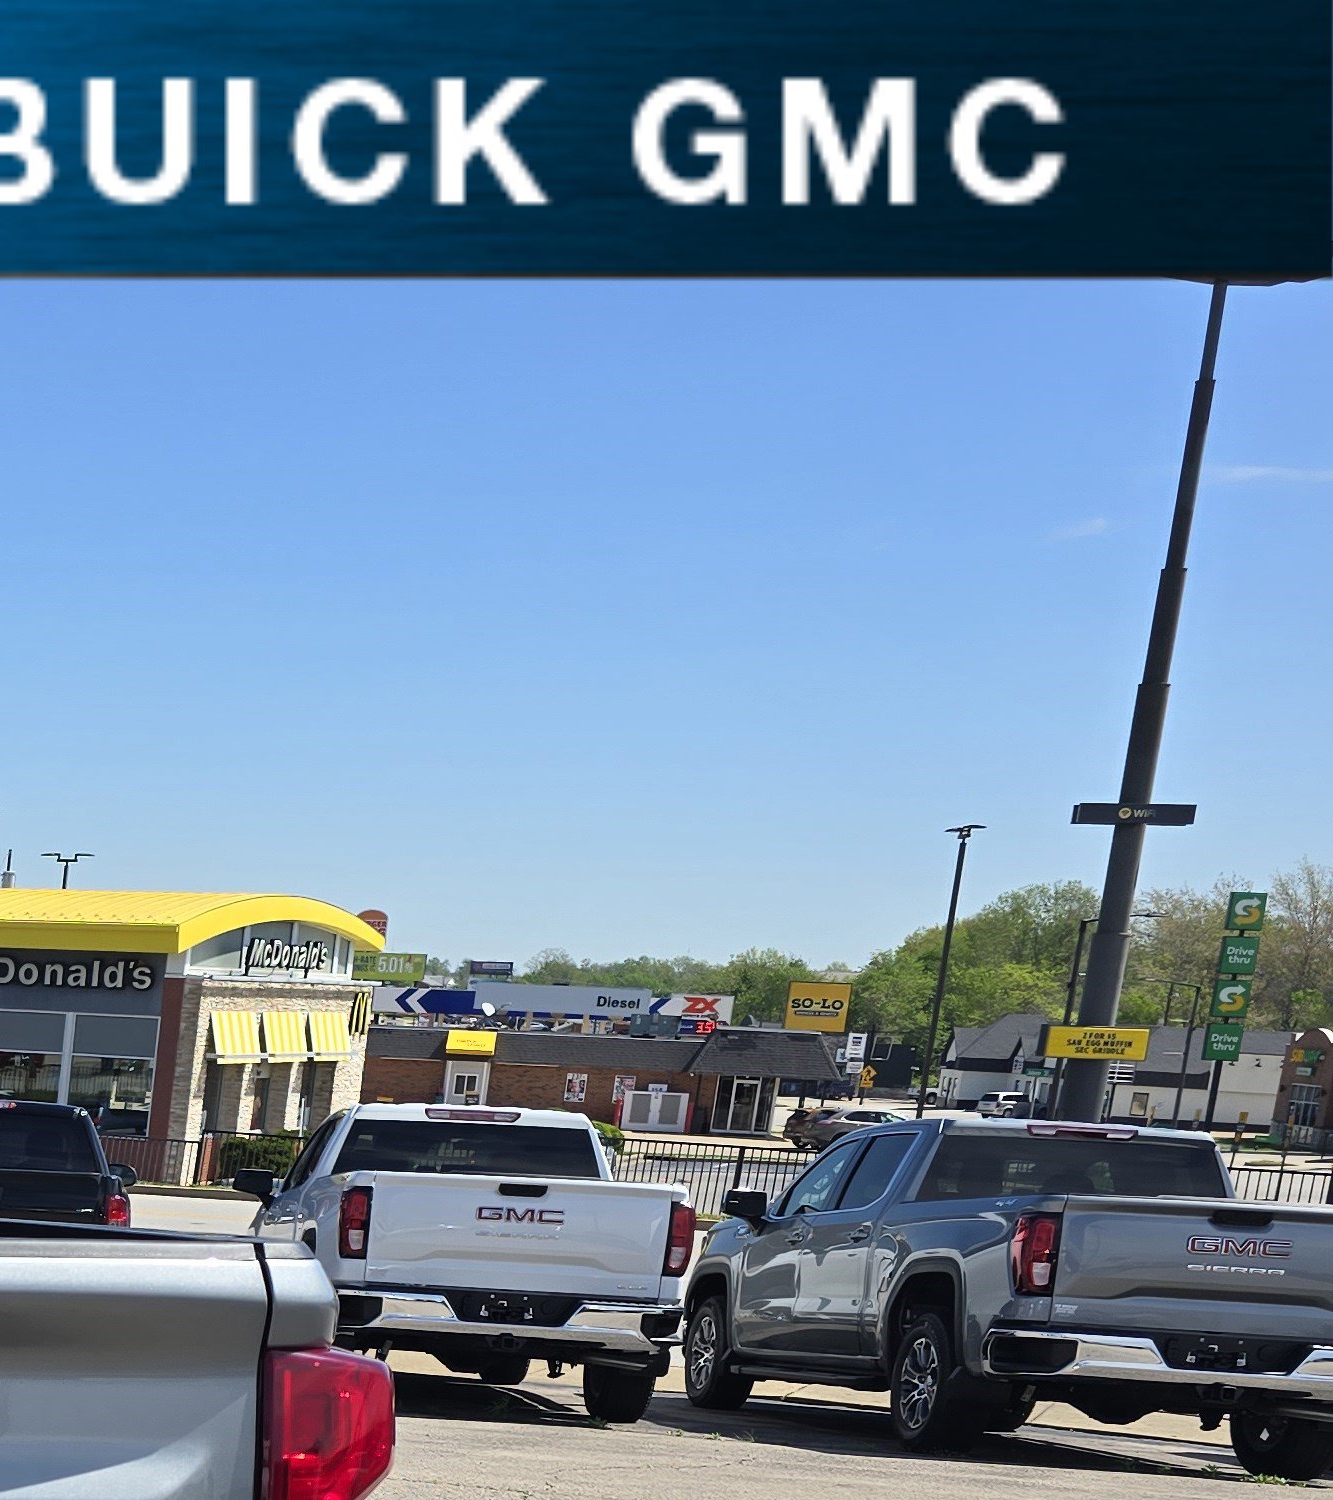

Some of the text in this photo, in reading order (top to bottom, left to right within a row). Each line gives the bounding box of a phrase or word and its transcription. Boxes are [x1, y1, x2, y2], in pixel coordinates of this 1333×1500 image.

[247, 937, 329, 971] McDonald's
[1226, 946, 1255, 957] Drive
[1227, 955, 1251, 965] thru
[596, 995, 641, 1009] Diesel
[791, 997, 845, 1011] SO-LO
[1086, 1039, 1100, 1047] EGG
[1102, 1040, 1133, 1048] MUFFIN
[1210, 1033, 1239, 1043] Drive
[1212, 1042, 1236, 1051] thru
[475, 1206, 565, 1226] GMC
[1187, 1234, 1294, 1260] GMC
[1186, 1263, 1286, 1277] SIERRA
